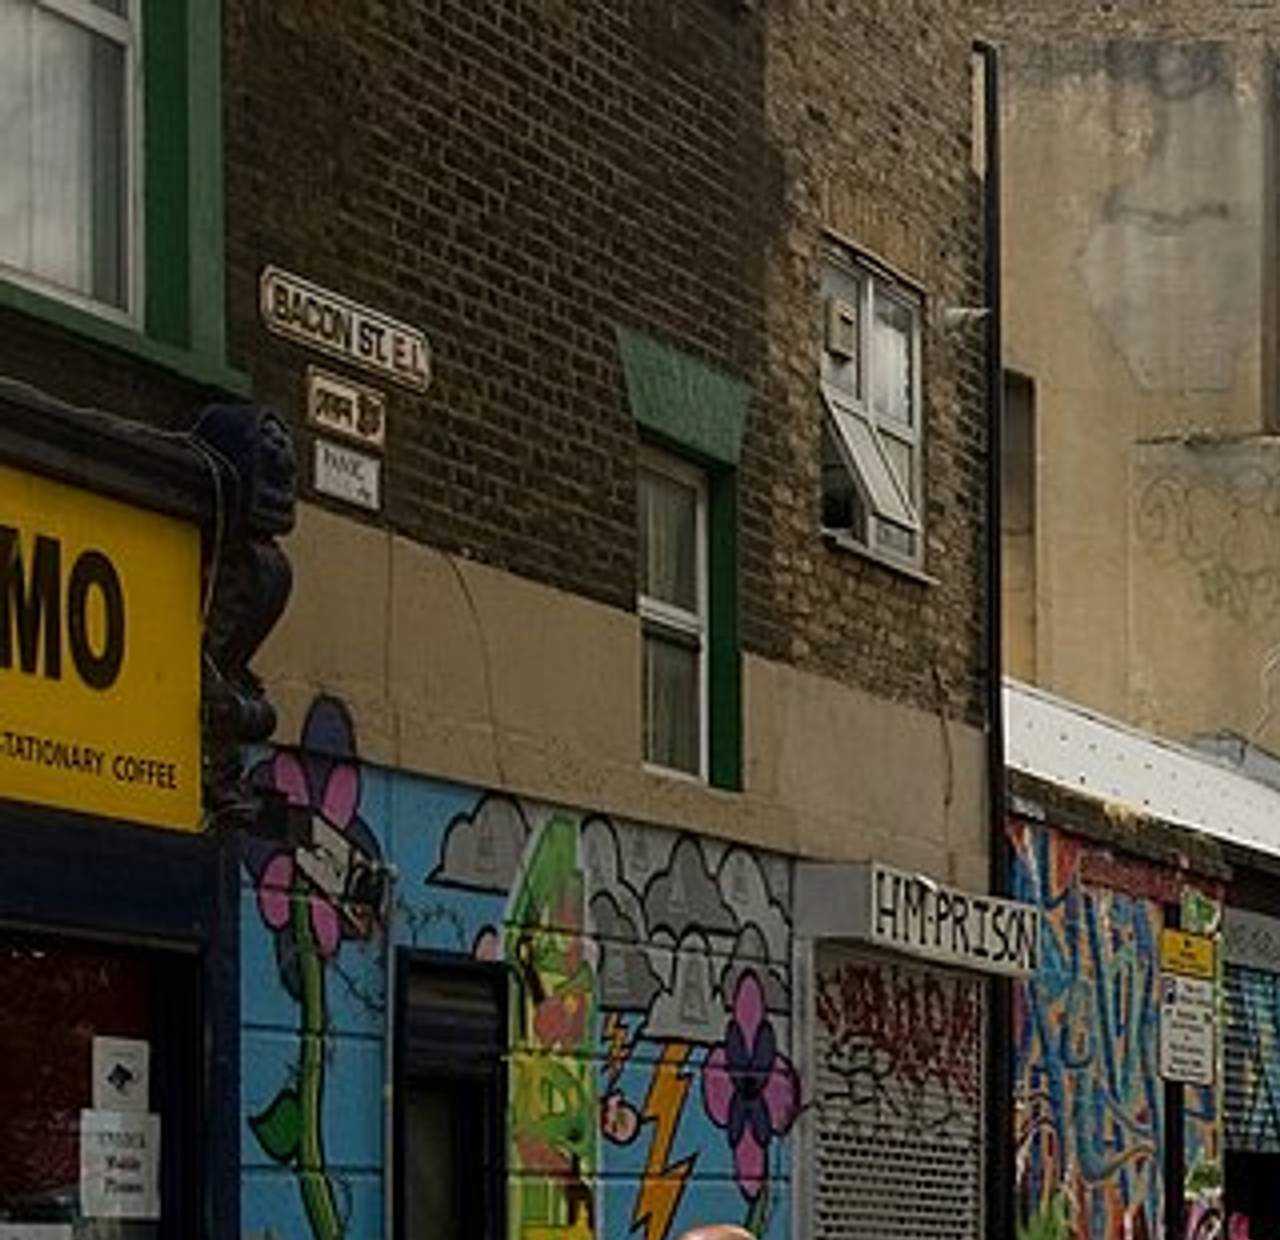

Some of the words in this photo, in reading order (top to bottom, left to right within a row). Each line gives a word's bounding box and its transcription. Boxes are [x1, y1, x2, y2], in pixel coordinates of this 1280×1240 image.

[274, 284, 352, 348] BACON
[0, 731, 105, 777] TATIONARY
[112, 755, 178, 790] COFFEE
